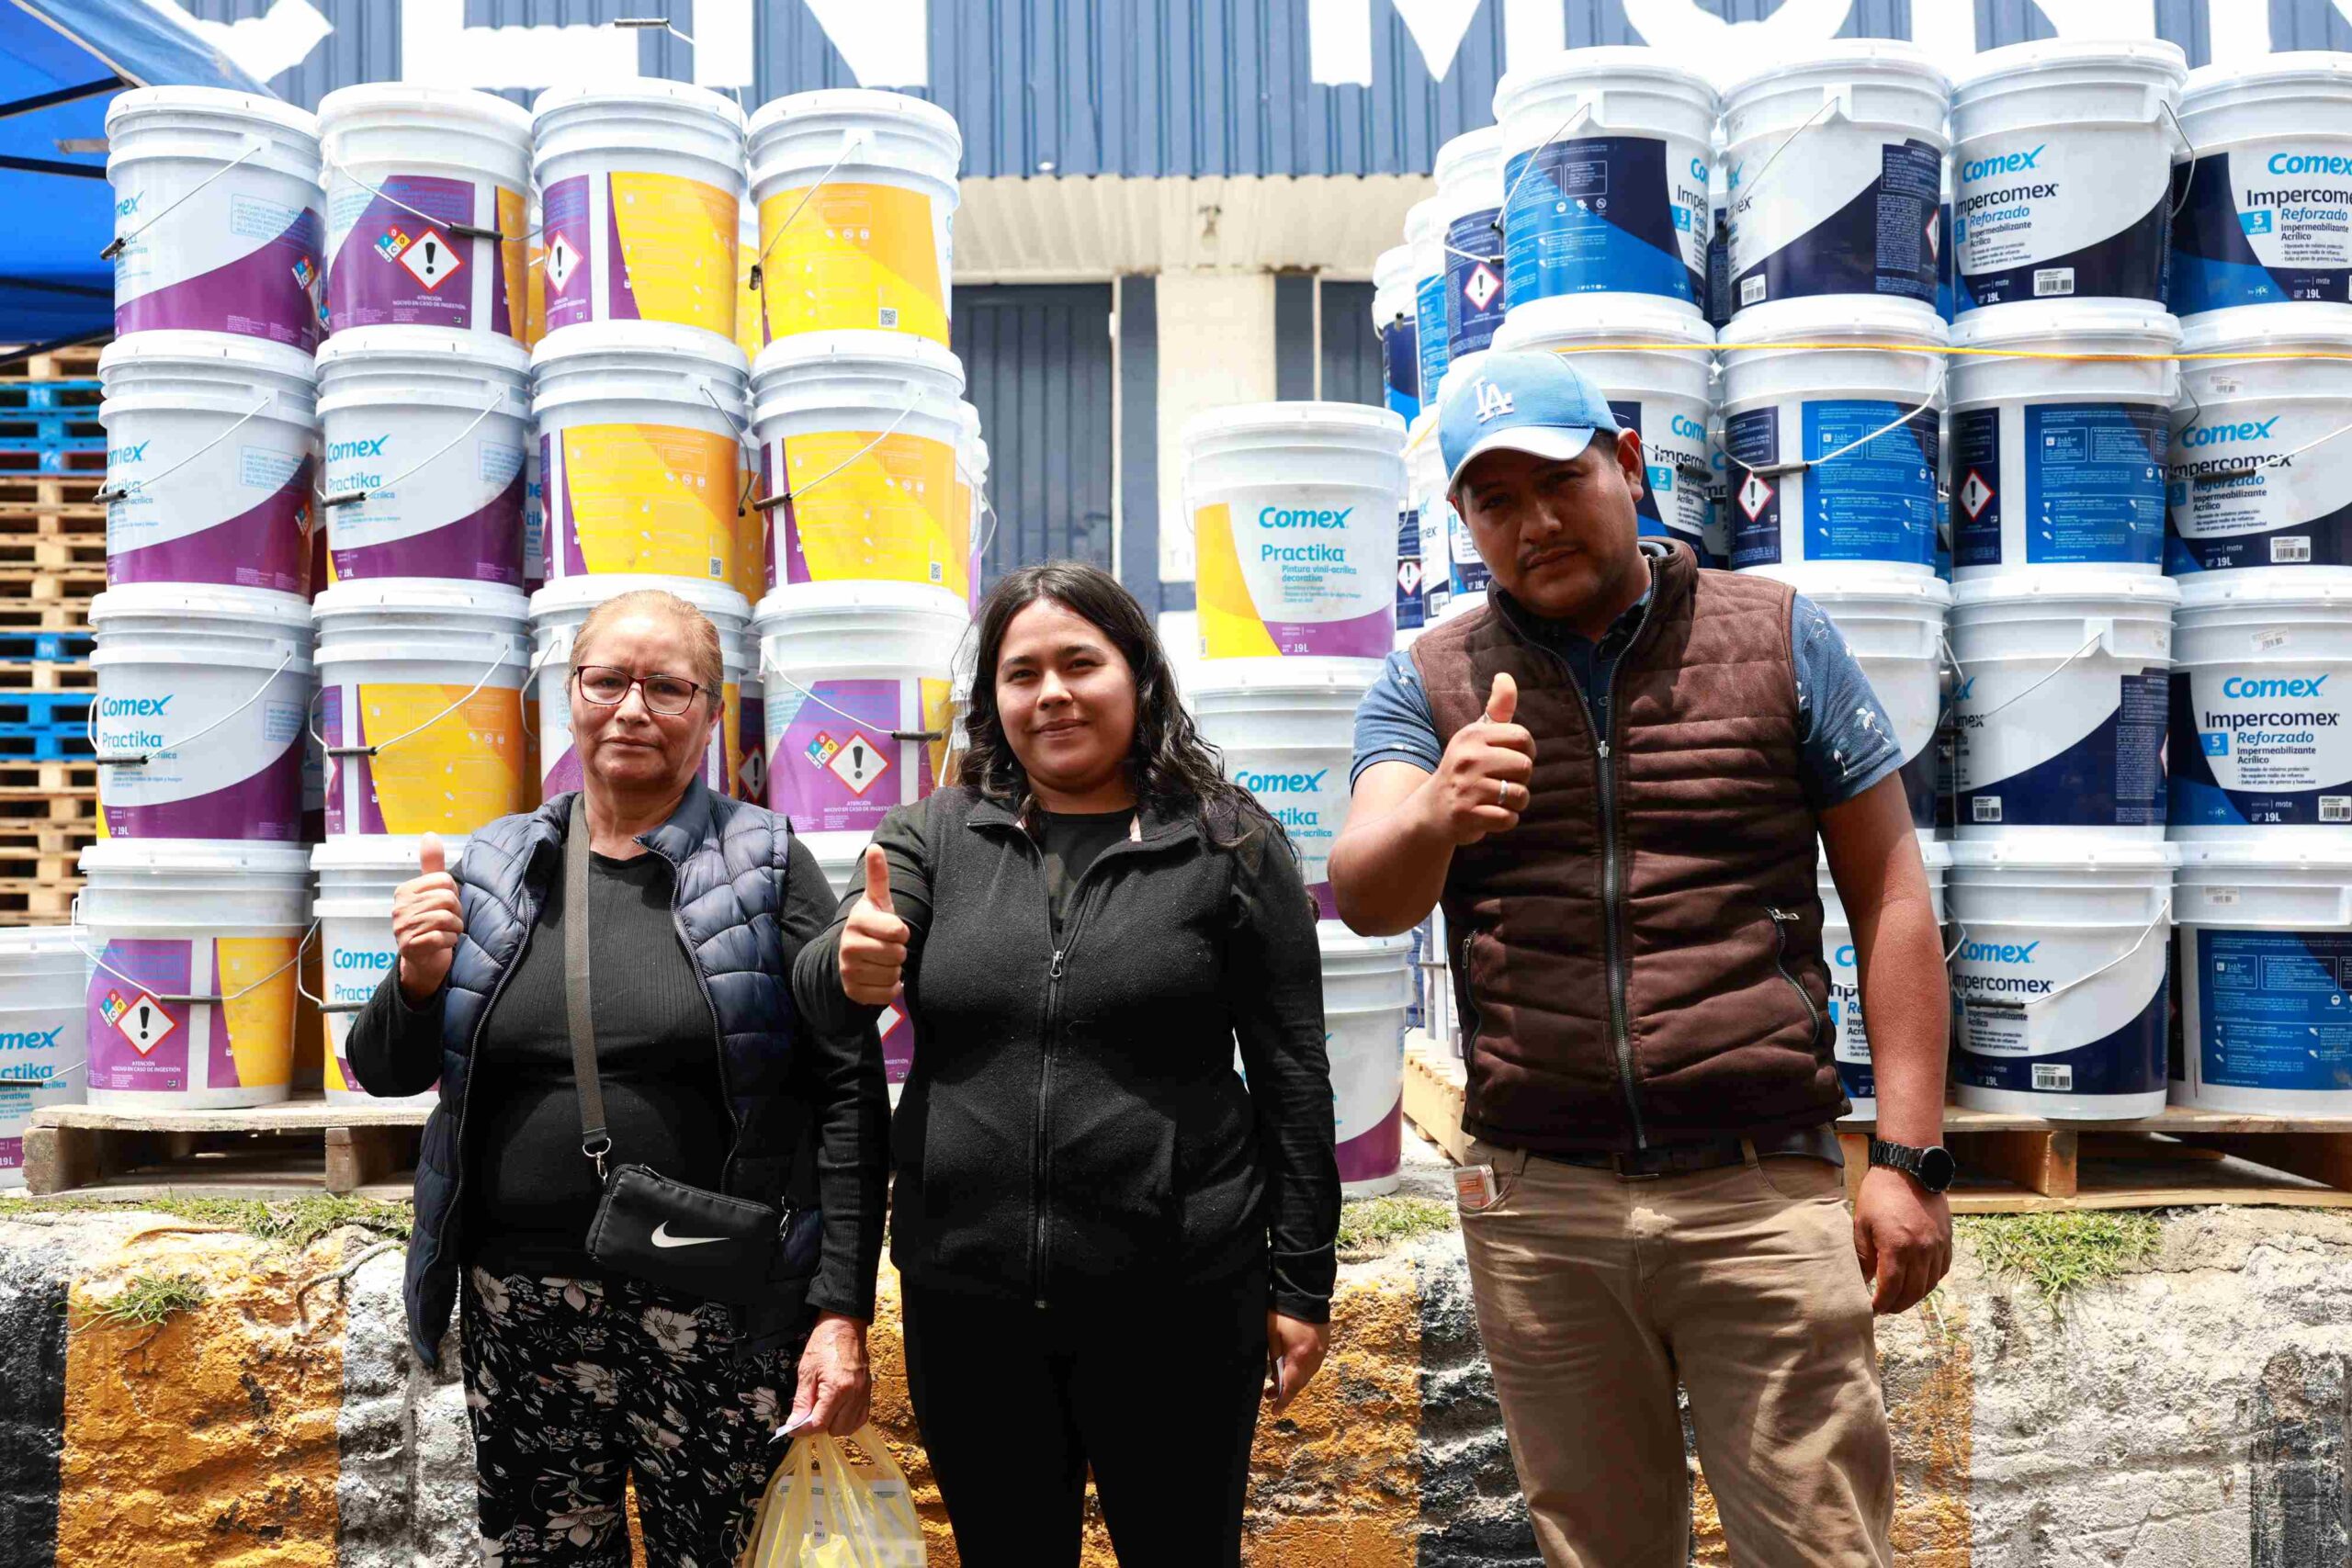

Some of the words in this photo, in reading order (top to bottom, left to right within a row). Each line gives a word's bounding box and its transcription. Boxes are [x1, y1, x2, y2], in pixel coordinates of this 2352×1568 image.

[1962, 142, 2046, 183] Comex
[2247, 189, 2352, 209] Impercom
[1970, 206, 2030, 229] Reforzado
[2254, 212, 2263, 225] 5
[2281, 208, 2347, 222] Reforzado
[2281, 223, 2349, 234] Impermeabilizante
[2281, 231, 2312, 242] Acrílico
[1987, 291, 2001, 303] 19L
[2306, 288, 2322, 299] 19L
[1473, 375, 1515, 424] LA
[2182, 415, 2280, 448] Comex
[327, 434, 390, 463] Comex
[329, 472, 381, 492] Practika
[1657, 468, 1666, 481] 5
[1259, 506, 1354, 530] Comex
[1261, 544, 1345, 562] Practika
[2217, 556, 2233, 568] 19L
[1294, 642, 1309, 653] 19L
[2222, 673, 2329, 698] Comex
[102, 694, 175, 716] Comex
[2206, 711, 2340, 732] Impercomex
[102, 730, 163, 748] Practika
[2211, 736, 2221, 748] 5
[2236, 730, 2314, 746] Reforzado
[2237, 746, 2316, 758] Impermeabilizante
[2237, 755, 2269, 765] Acrílico
[2275, 800, 2293, 808] mate
[2265, 811, 2282, 822] 19L
[118, 826, 130, 836] 19L
[1959, 940, 2041, 964] Comex
[0, 1025, 64, 1050] mex
